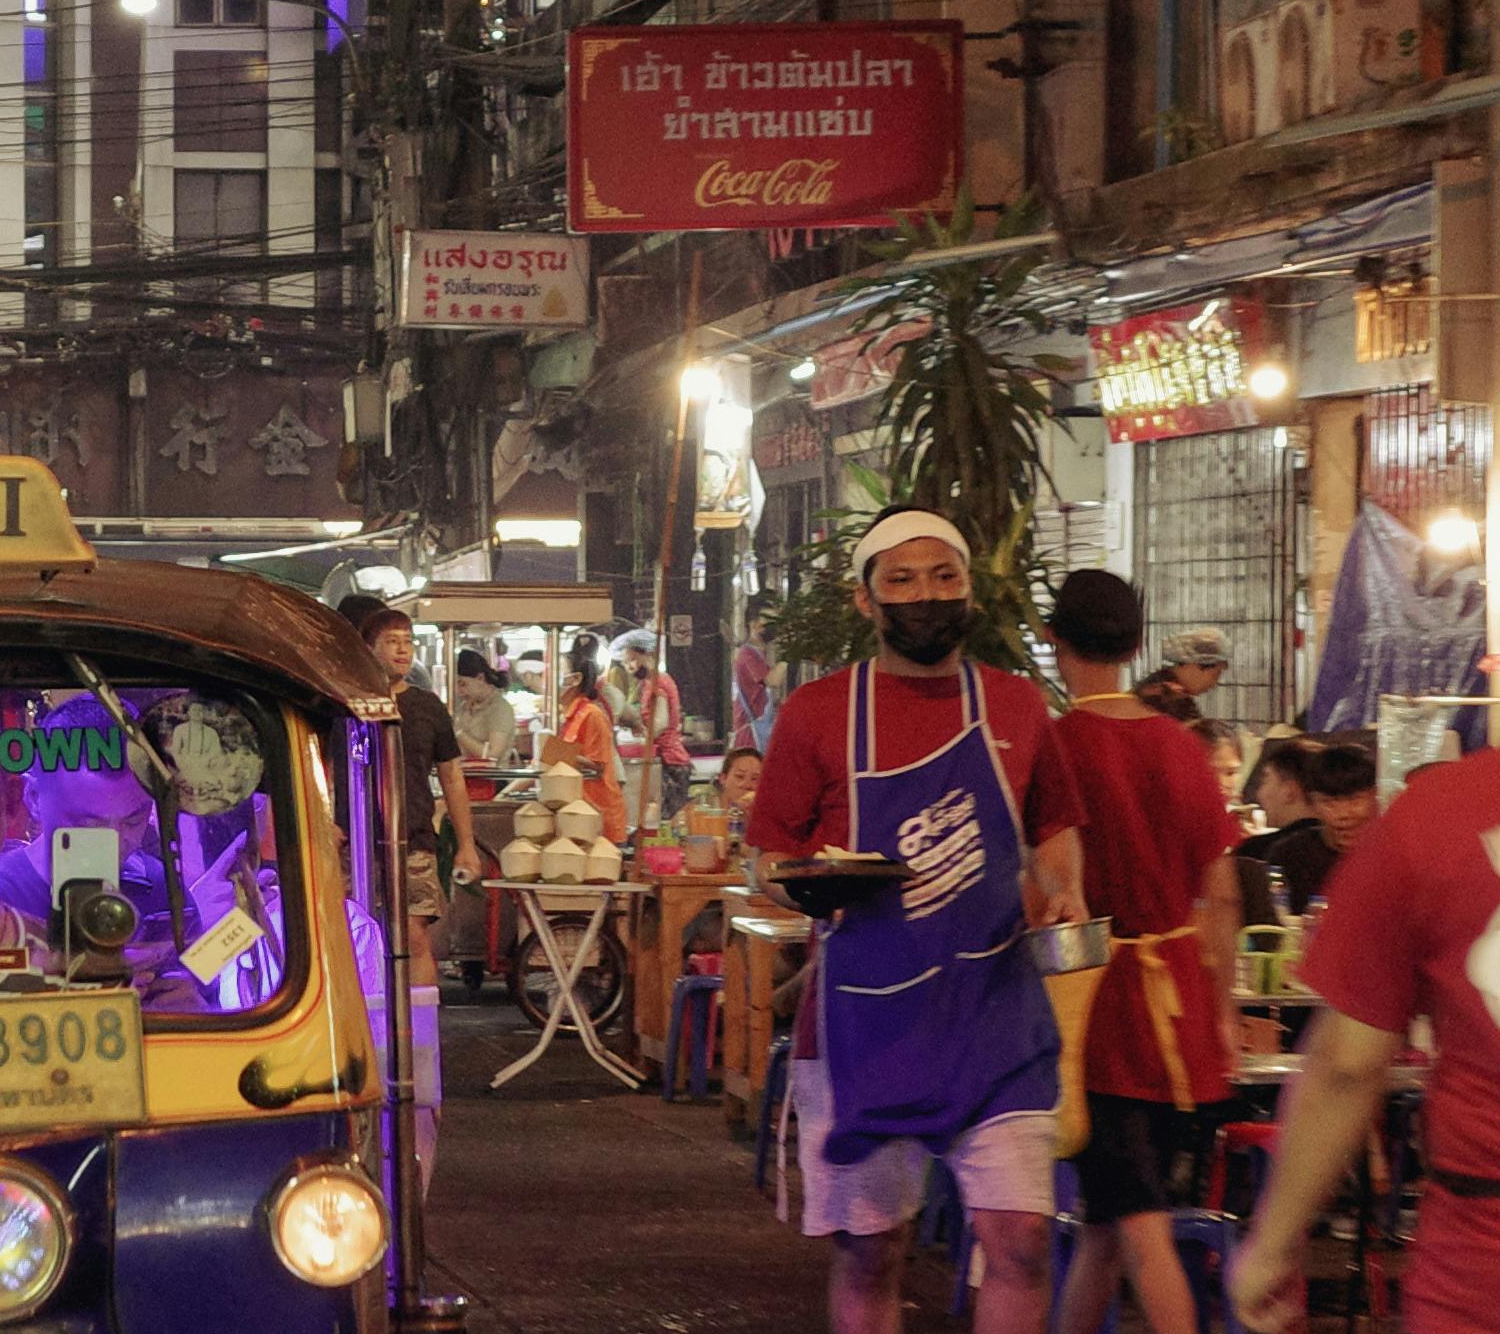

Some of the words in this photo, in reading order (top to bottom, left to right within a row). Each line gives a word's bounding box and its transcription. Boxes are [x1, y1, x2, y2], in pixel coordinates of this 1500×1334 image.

[704, 49, 915, 89] ข้าวต้มปลา
[663, 94, 874, 141] ยำสามแซ่บ
[694, 158, 842, 208] Coca-Cola
[424, 243, 568, 279] แสงอรุณ
